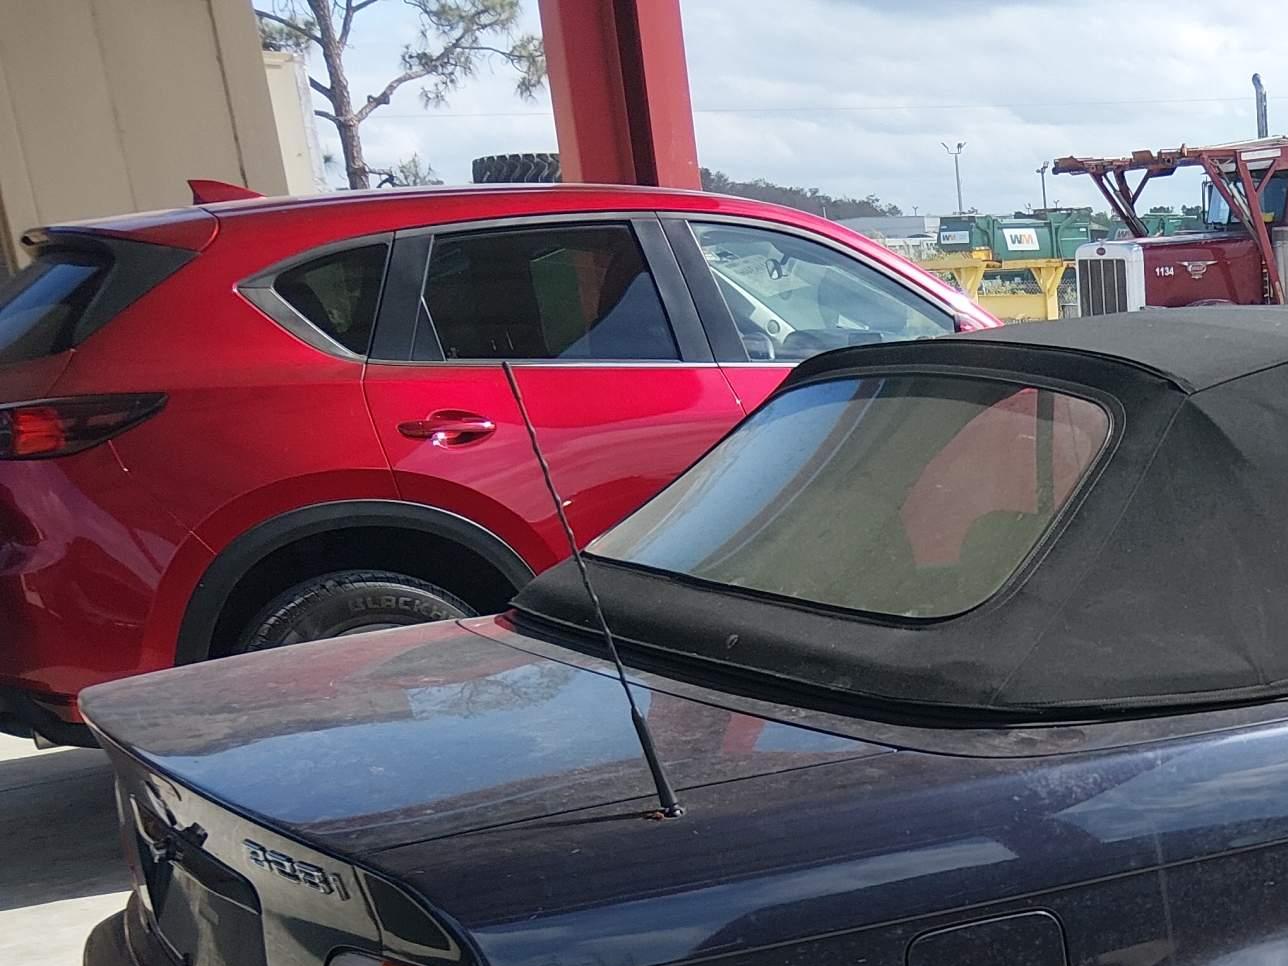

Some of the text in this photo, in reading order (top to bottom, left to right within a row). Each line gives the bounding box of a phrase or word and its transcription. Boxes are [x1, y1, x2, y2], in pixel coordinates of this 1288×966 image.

[1009, 233, 1034, 245] WM
[1155, 266, 1174, 277] 1134
[348, 595, 454, 619] BLACKH
